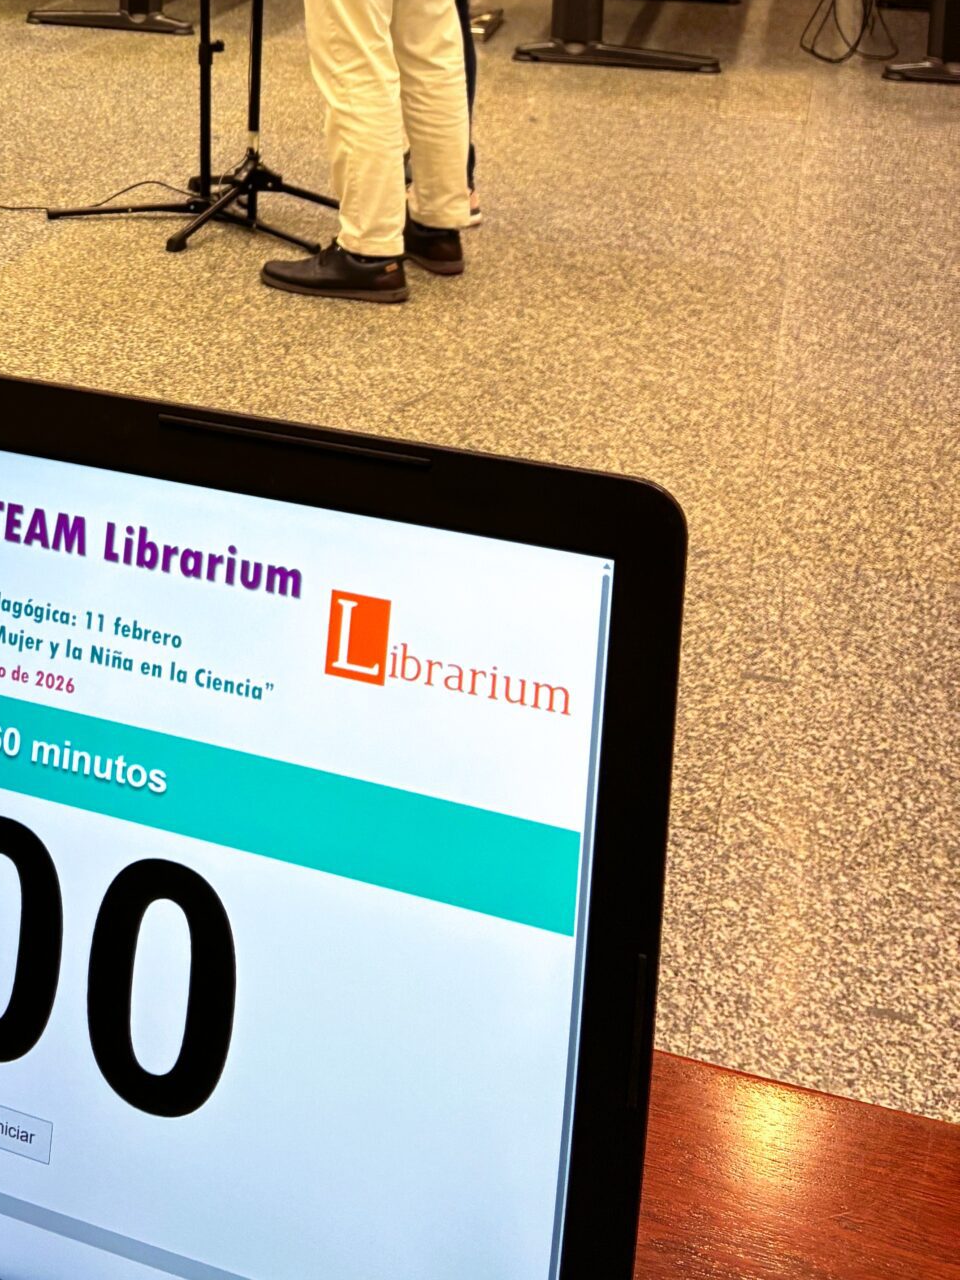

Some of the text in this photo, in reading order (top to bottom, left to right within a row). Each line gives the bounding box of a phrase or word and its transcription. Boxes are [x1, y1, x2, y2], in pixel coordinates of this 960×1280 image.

[104, 521, 303, 599] Librarium
[85, 611, 104, 632] 11
[114, 617, 182, 649] febrero
[12, 665, 29, 684] de
[35, 670, 76, 694] 2026
[50, 640, 60, 660] y
[66, 639, 82, 660] la
[90, 645, 134, 672] Niña
[140, 661, 162, 678] en
[170, 662, 188, 684] la
[332, 598, 571, 716] Librarium
[30, 736, 168, 794] minutos
